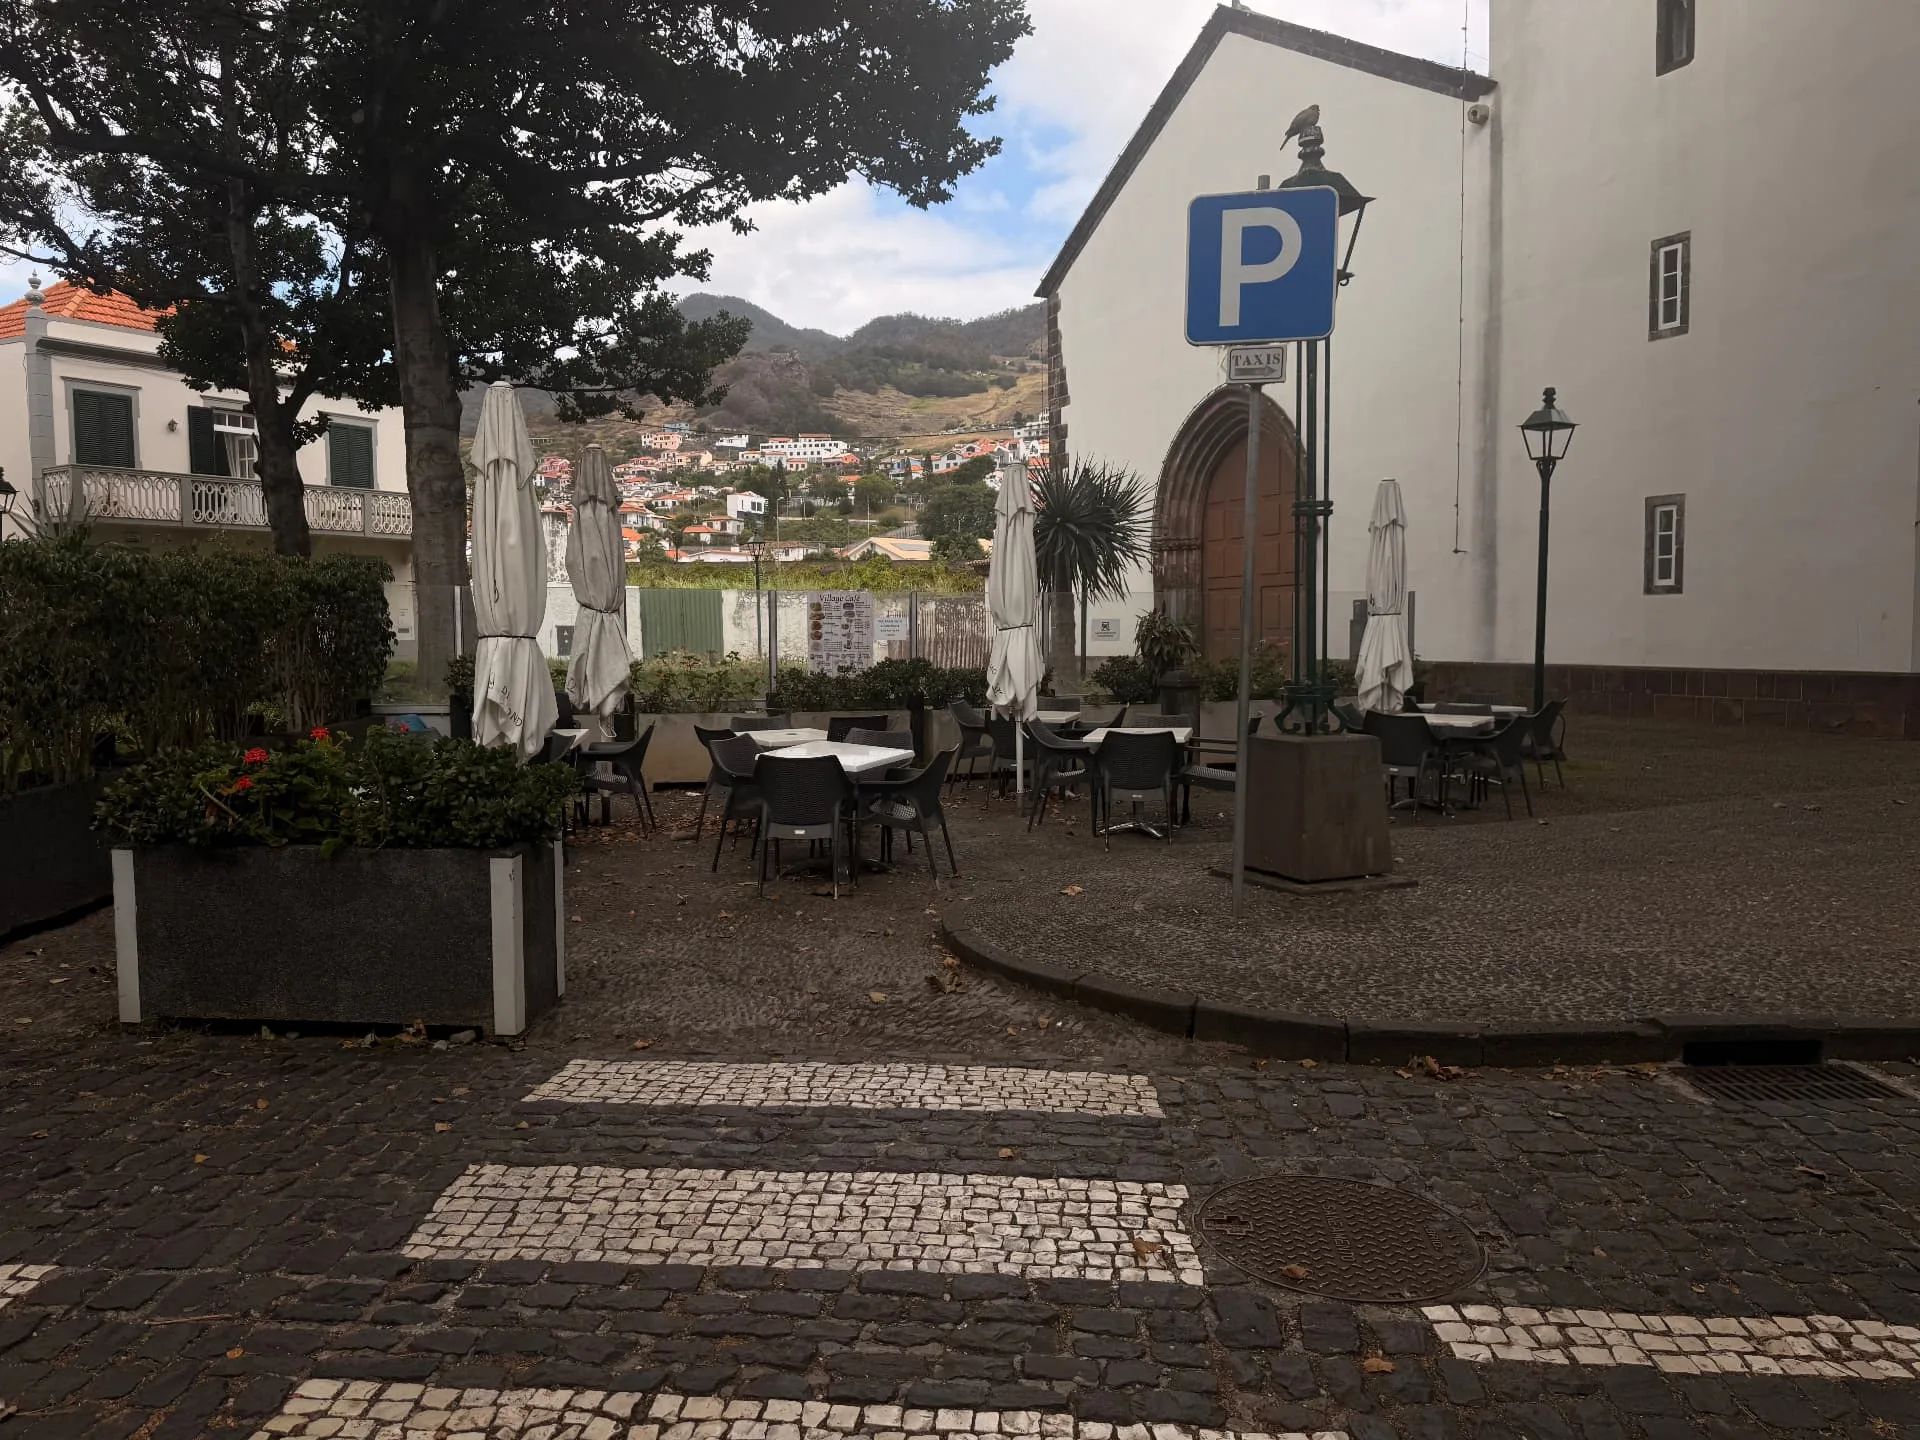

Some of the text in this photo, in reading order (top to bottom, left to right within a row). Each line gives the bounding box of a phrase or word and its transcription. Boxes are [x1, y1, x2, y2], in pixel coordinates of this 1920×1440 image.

[1219, 207, 1302, 326] P
[1232, 353, 1280, 366] TAXIS
[819, 594, 860, 603] Village Café
